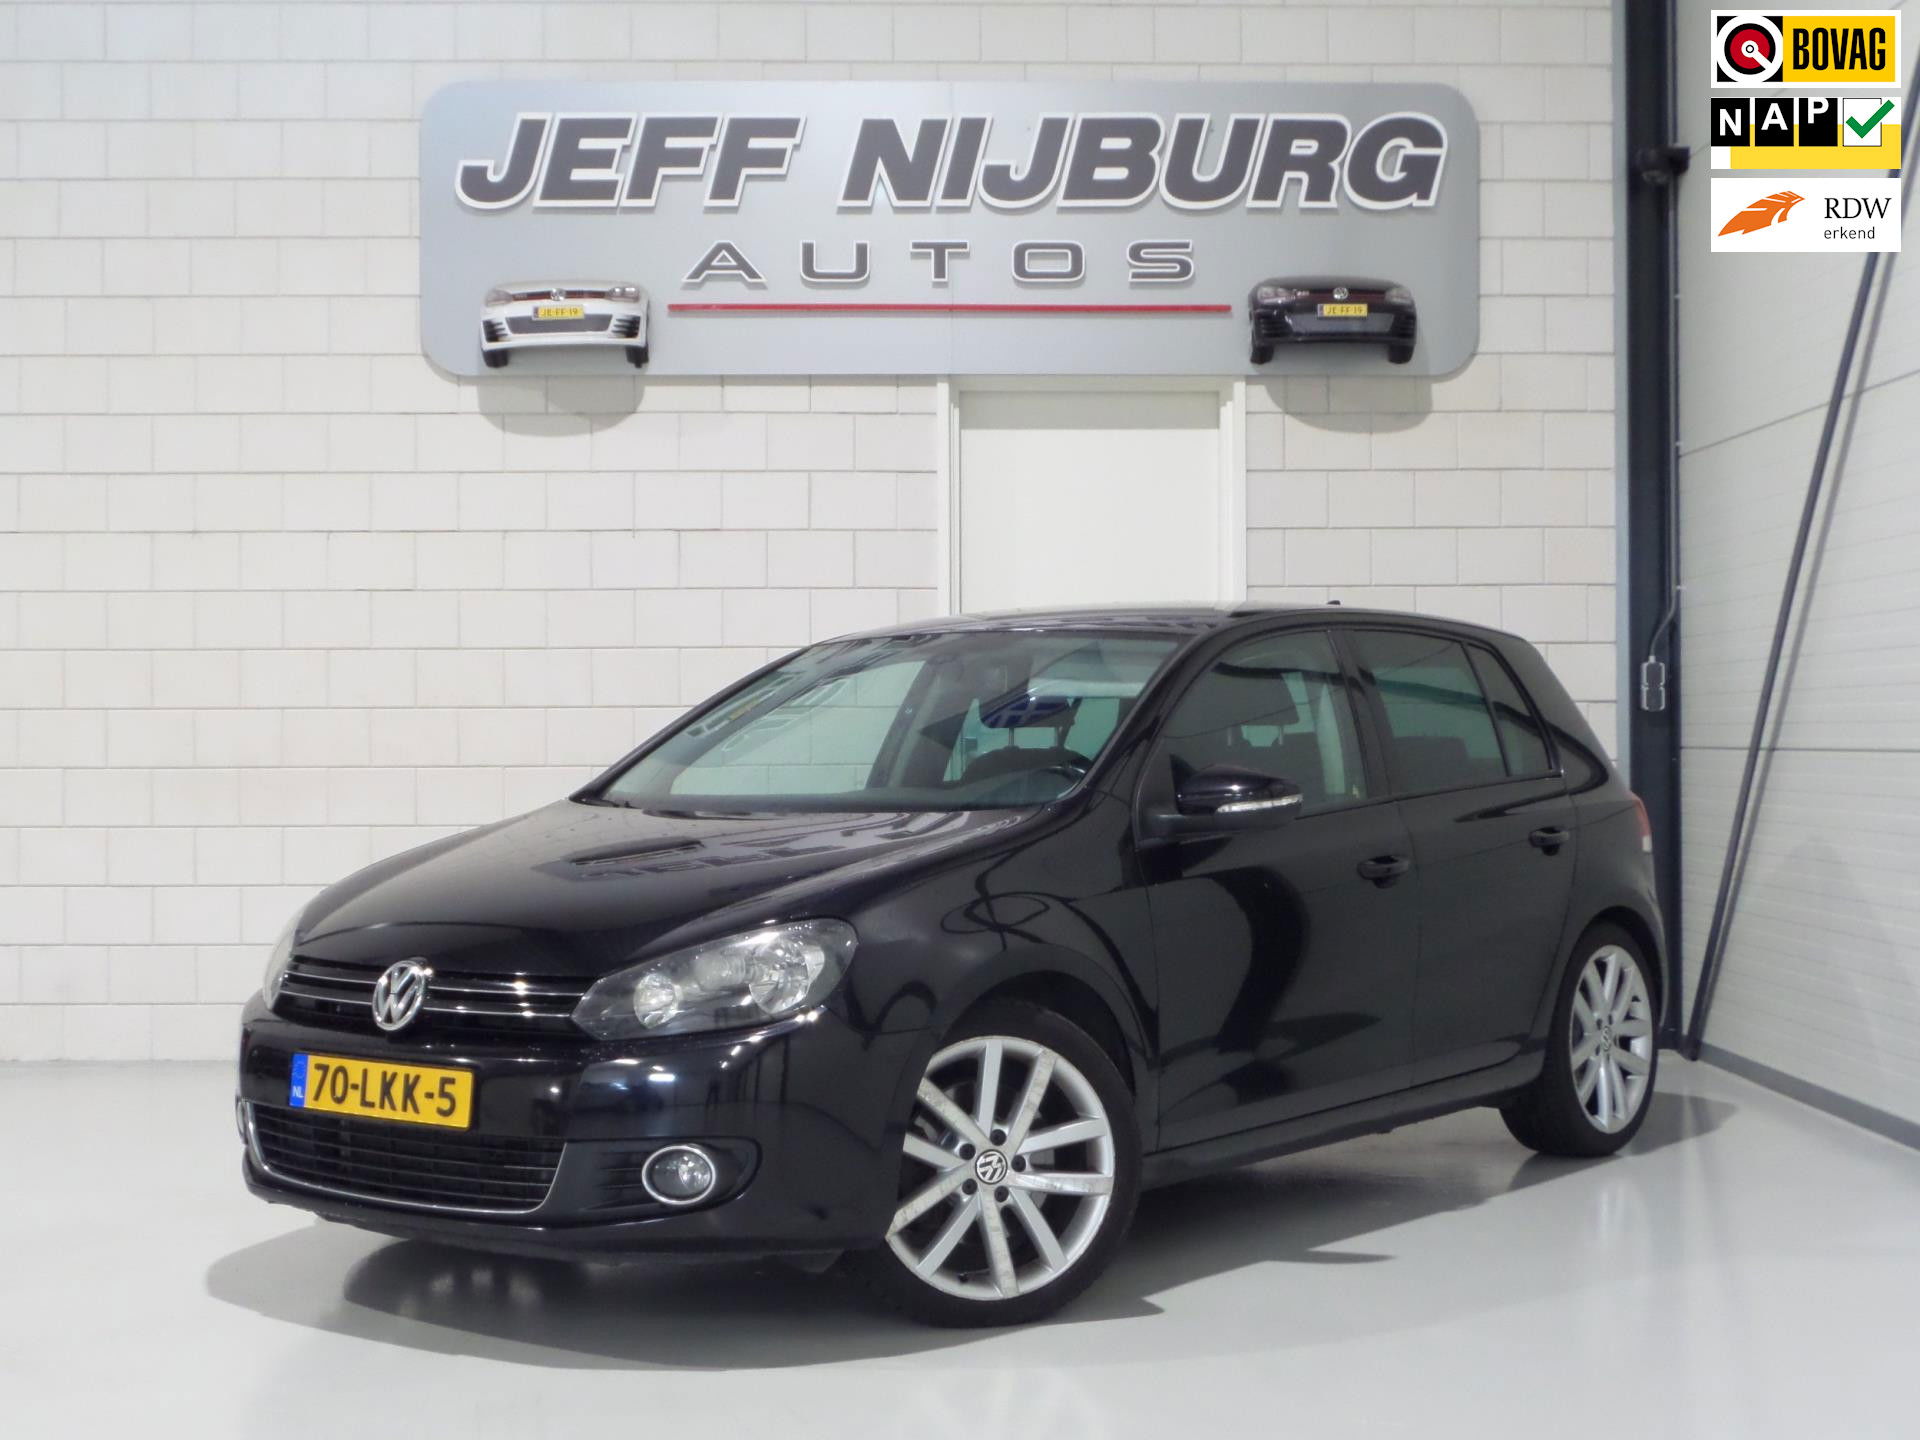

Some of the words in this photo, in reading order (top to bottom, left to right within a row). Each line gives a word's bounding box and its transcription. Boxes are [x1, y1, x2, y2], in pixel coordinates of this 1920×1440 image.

[455, 112, 806, 209] JEFF
[837, 112, 1448, 210] NIJBURG
[681, 240, 1195, 284] AUTOS
[292, 1085, 304, 1098] NL
[313, 1062, 456, 1117] 70-LKK-5
